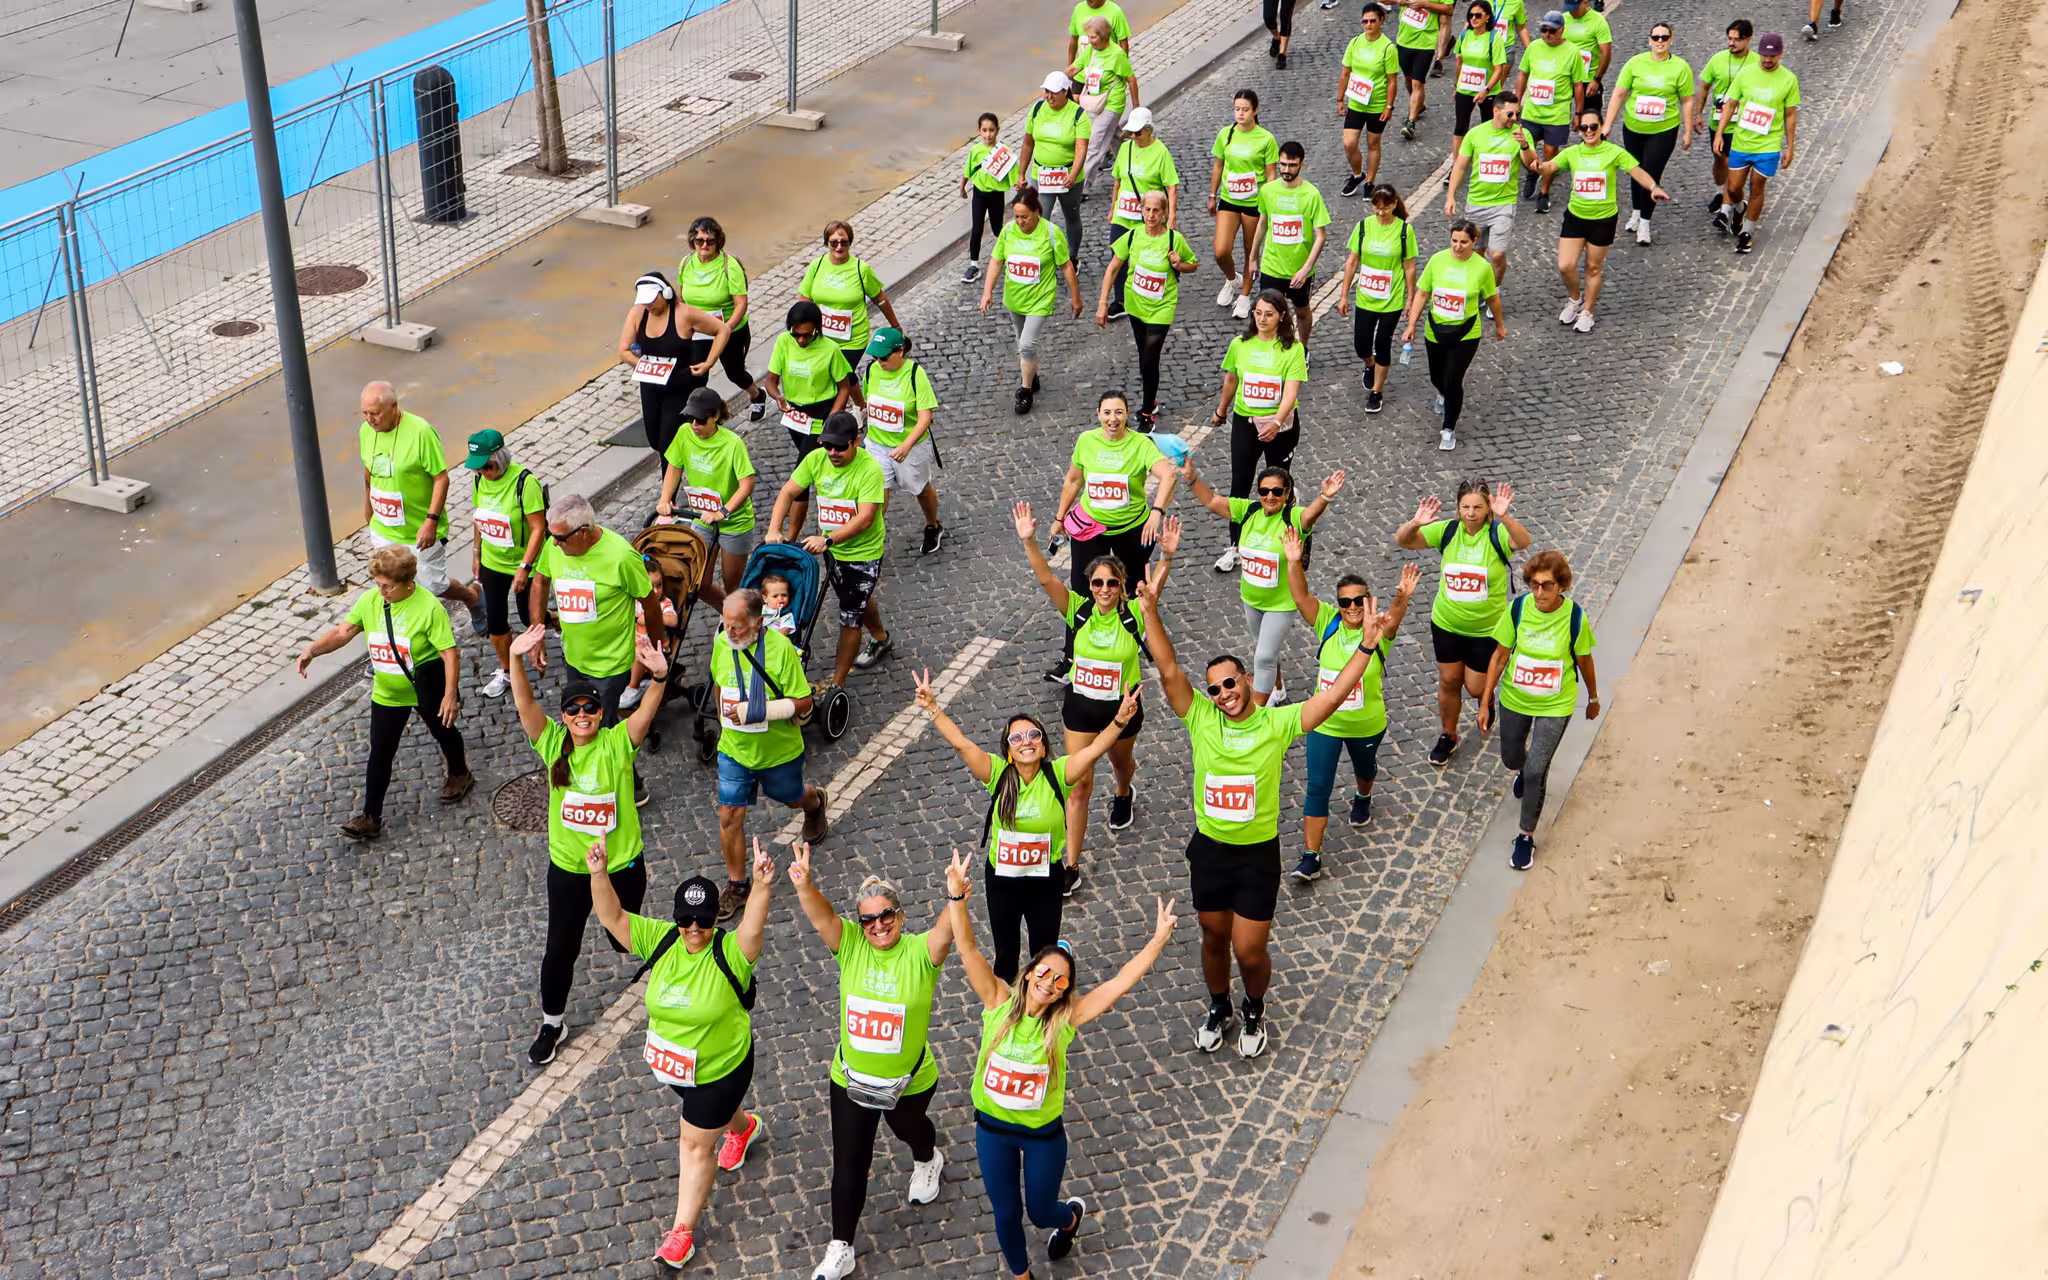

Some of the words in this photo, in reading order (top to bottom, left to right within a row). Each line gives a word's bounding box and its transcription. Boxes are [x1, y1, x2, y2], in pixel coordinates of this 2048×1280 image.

[1480, 163, 1505, 174] 5156
[1040, 175, 1065, 185] 5044
[1228, 181, 1253, 192] 5063
[1576, 181, 1602, 191] 5155
[1273, 224, 1299, 235] 5066
[1009, 263, 1035, 277] 5116
[1135, 276, 1160, 291] 5019
[1360, 276, 1386, 289] 5065
[1435, 296, 1460, 311] 5064
[640, 361, 667, 376] 5014
[1245, 385, 1275, 399] 5095
[870, 408, 898, 422] 5056
[1088, 485, 1121, 499] 5090
[690, 498, 718, 512] 5058
[820, 508, 851, 523] 5059
[1241, 559, 1271, 578] 5078
[1448, 577, 1479, 591] 5029
[1077, 669, 1113, 689] 5085
[1515, 670, 1552, 686] 5024
[1205, 790, 1247, 809] 5117
[564, 807, 607, 825] 5096
[999, 845, 1041, 863] 5109
[848, 1013, 892, 1037] 5110
[646, 1049, 686, 1077] 5175
[986, 1063, 1033, 1097] 5112
